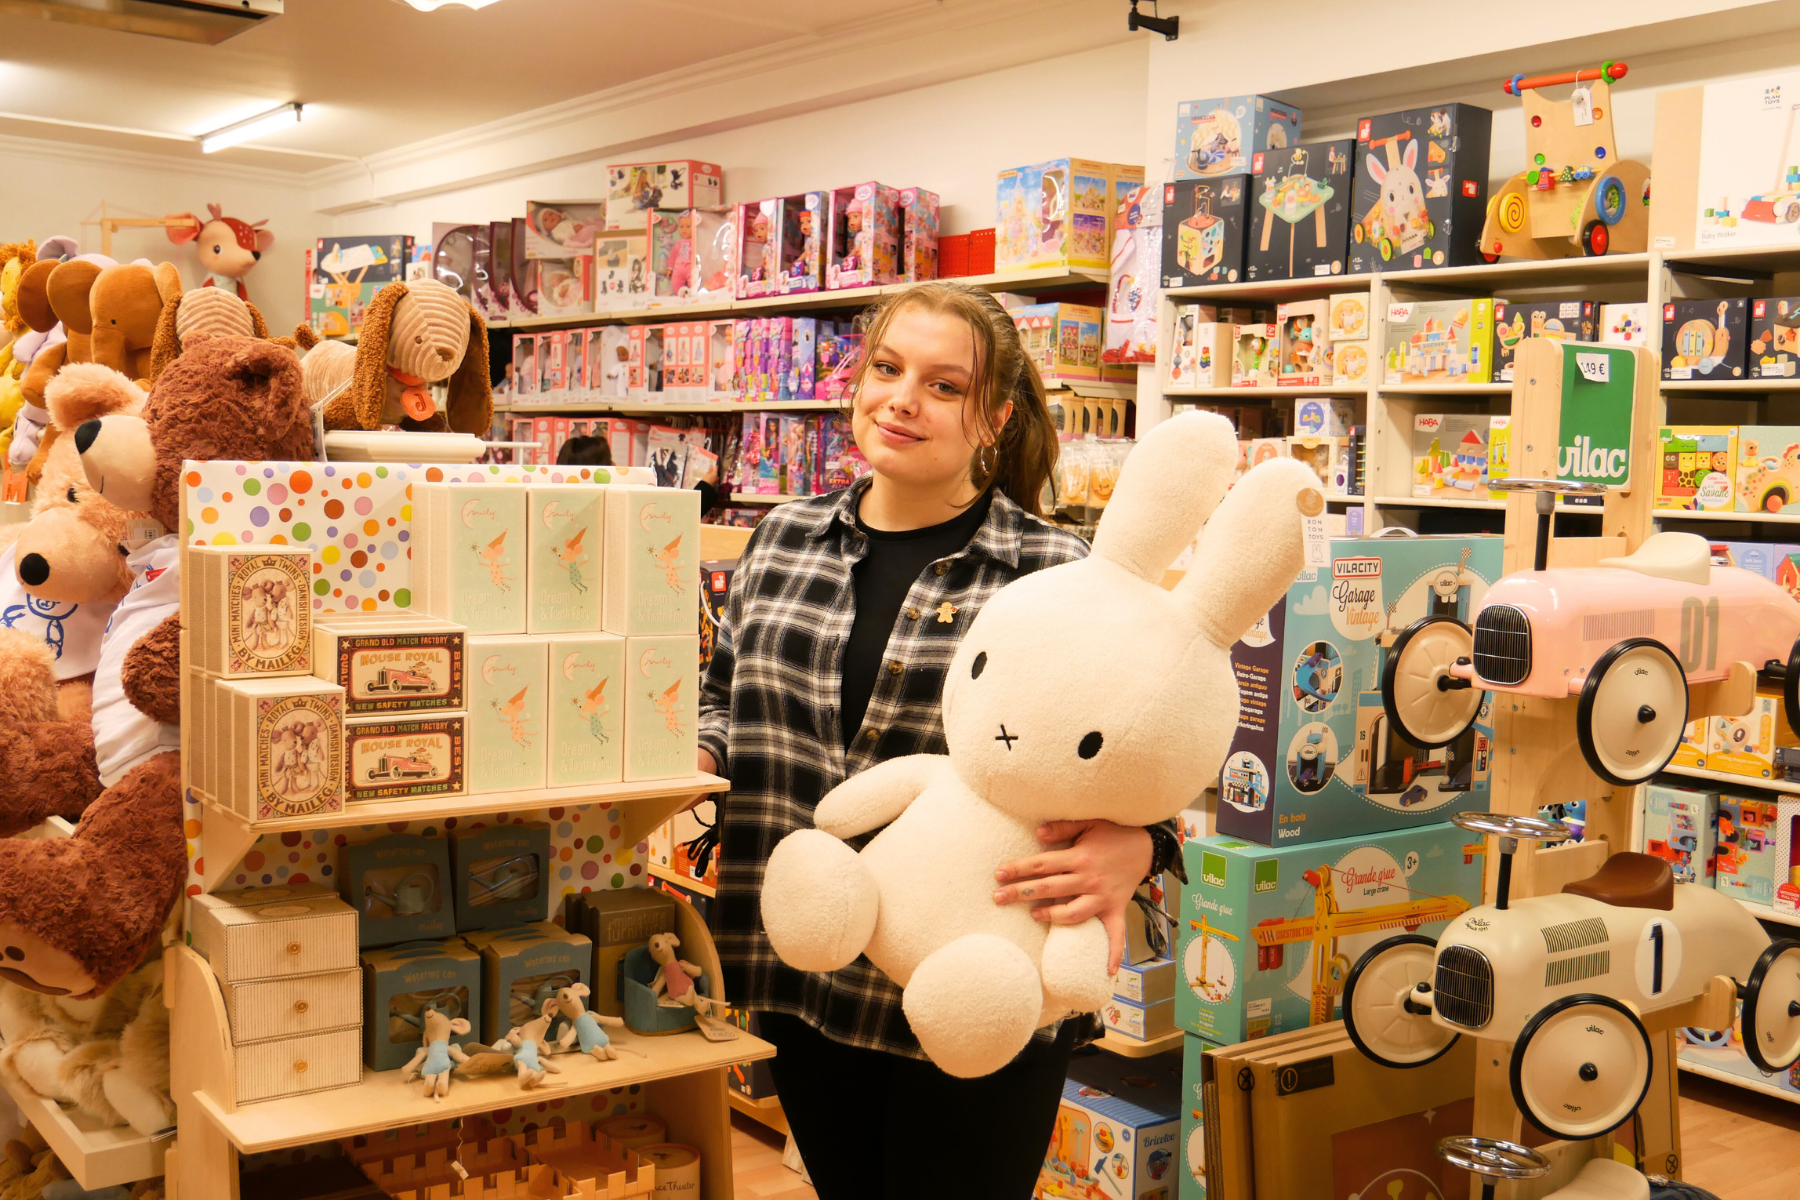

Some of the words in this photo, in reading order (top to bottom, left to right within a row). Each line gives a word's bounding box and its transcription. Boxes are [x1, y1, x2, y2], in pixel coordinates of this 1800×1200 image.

[1702, 232, 1716, 240] Baby
[1391, 308, 1409, 317] HABA
[1599, 363, 1605, 375] €
[1419, 418, 1438, 427] HABA
[1557, 435, 1626, 478] vilac
[1700, 486, 1729, 497] Savane
[237, 560, 261, 581] ROYAL
[279, 559, 301, 580] TWINS
[1336, 562, 1378, 573] VILACITY
[231, 585, 241, 621] MATCHES
[298, 584, 307, 612] DANISH
[462, 591, 492, 604] Dream
[542, 590, 571, 604] Dream
[638, 593, 668, 607] Dream
[1333, 580, 1375, 612] Garage
[1346, 606, 1379, 631] Vintage
[231, 622, 241, 643] MINI
[298, 613, 307, 640] DESIGN
[355, 638, 380, 647] GRAND
[382, 637, 395, 646] OLD
[397, 637, 419, 645] MATCH
[420, 636, 448, 644] FACTORY
[1679, 596, 1719, 673] 01
[238, 647, 255, 663] BY
[255, 645, 302, 670] MAILEG
[360, 652, 402, 666] MOUSE
[406, 652, 442, 663] ROYAL
[1252, 666, 1269, 674] Garage
[1634, 667, 1648, 676] vilac
[376, 701, 408, 709] SAFETY
[410, 699, 447, 707] MATCHES
[267, 702, 290, 724] ROYAL
[309, 700, 332, 720] TWINS
[356, 726, 380, 735] GRAND
[397, 724, 419, 732] MATCH
[421, 722, 448, 730] FACTORY
[1360, 731, 1366, 740] 16
[329, 724, 339, 753] DANISH
[638, 737, 667, 750] Dream
[260, 729, 270, 767] MATCHES
[361, 739, 402, 754] MOUSE
[406, 738, 443, 749] ROYAL
[561, 742, 592, 756] Dream
[481, 748, 513, 762] Dream
[329, 754, 339, 781] DESIGN
[260, 769, 270, 788] MINI
[357, 790, 375, 798] NEW
[377, 788, 409, 796] SAFETY
[411, 784, 448, 792] MATCHES
[266, 792, 284, 807] BY
[285, 787, 333, 813] MAILEG
[1279, 815, 1288, 823] En
[1291, 813, 1306, 822] bois
[1278, 827, 1300, 838] Wood
[518, 839, 529, 847] can
[376, 848, 409, 859] Watering
[412, 848, 425, 856] can
[1407, 856, 1417, 870] 3+
[1203, 873, 1224, 886] vilac
[1256, 881, 1276, 891] vilac
[1341, 866, 1377, 893] Grande
[1378, 868, 1395, 887] grue
[1363, 887, 1376, 896] Large
[1377, 885, 1389, 893] crane
[1192, 893, 1218, 910] Grande
[1219, 905, 1233, 916] grue
[614, 913, 666, 927] miniature
[607, 921, 666, 942] furniture
[1276, 926, 1313, 940] CONSTRUCTION
[524, 955, 556, 968] Watering
[559, 954, 570, 963] can
[1649, 923, 1663, 995] 1
[404, 970, 440, 983] Watering
[442, 969, 456, 978] can
[1586, 1025, 1604, 1035] vilac
[1563, 1103, 1581, 1112] vilac
